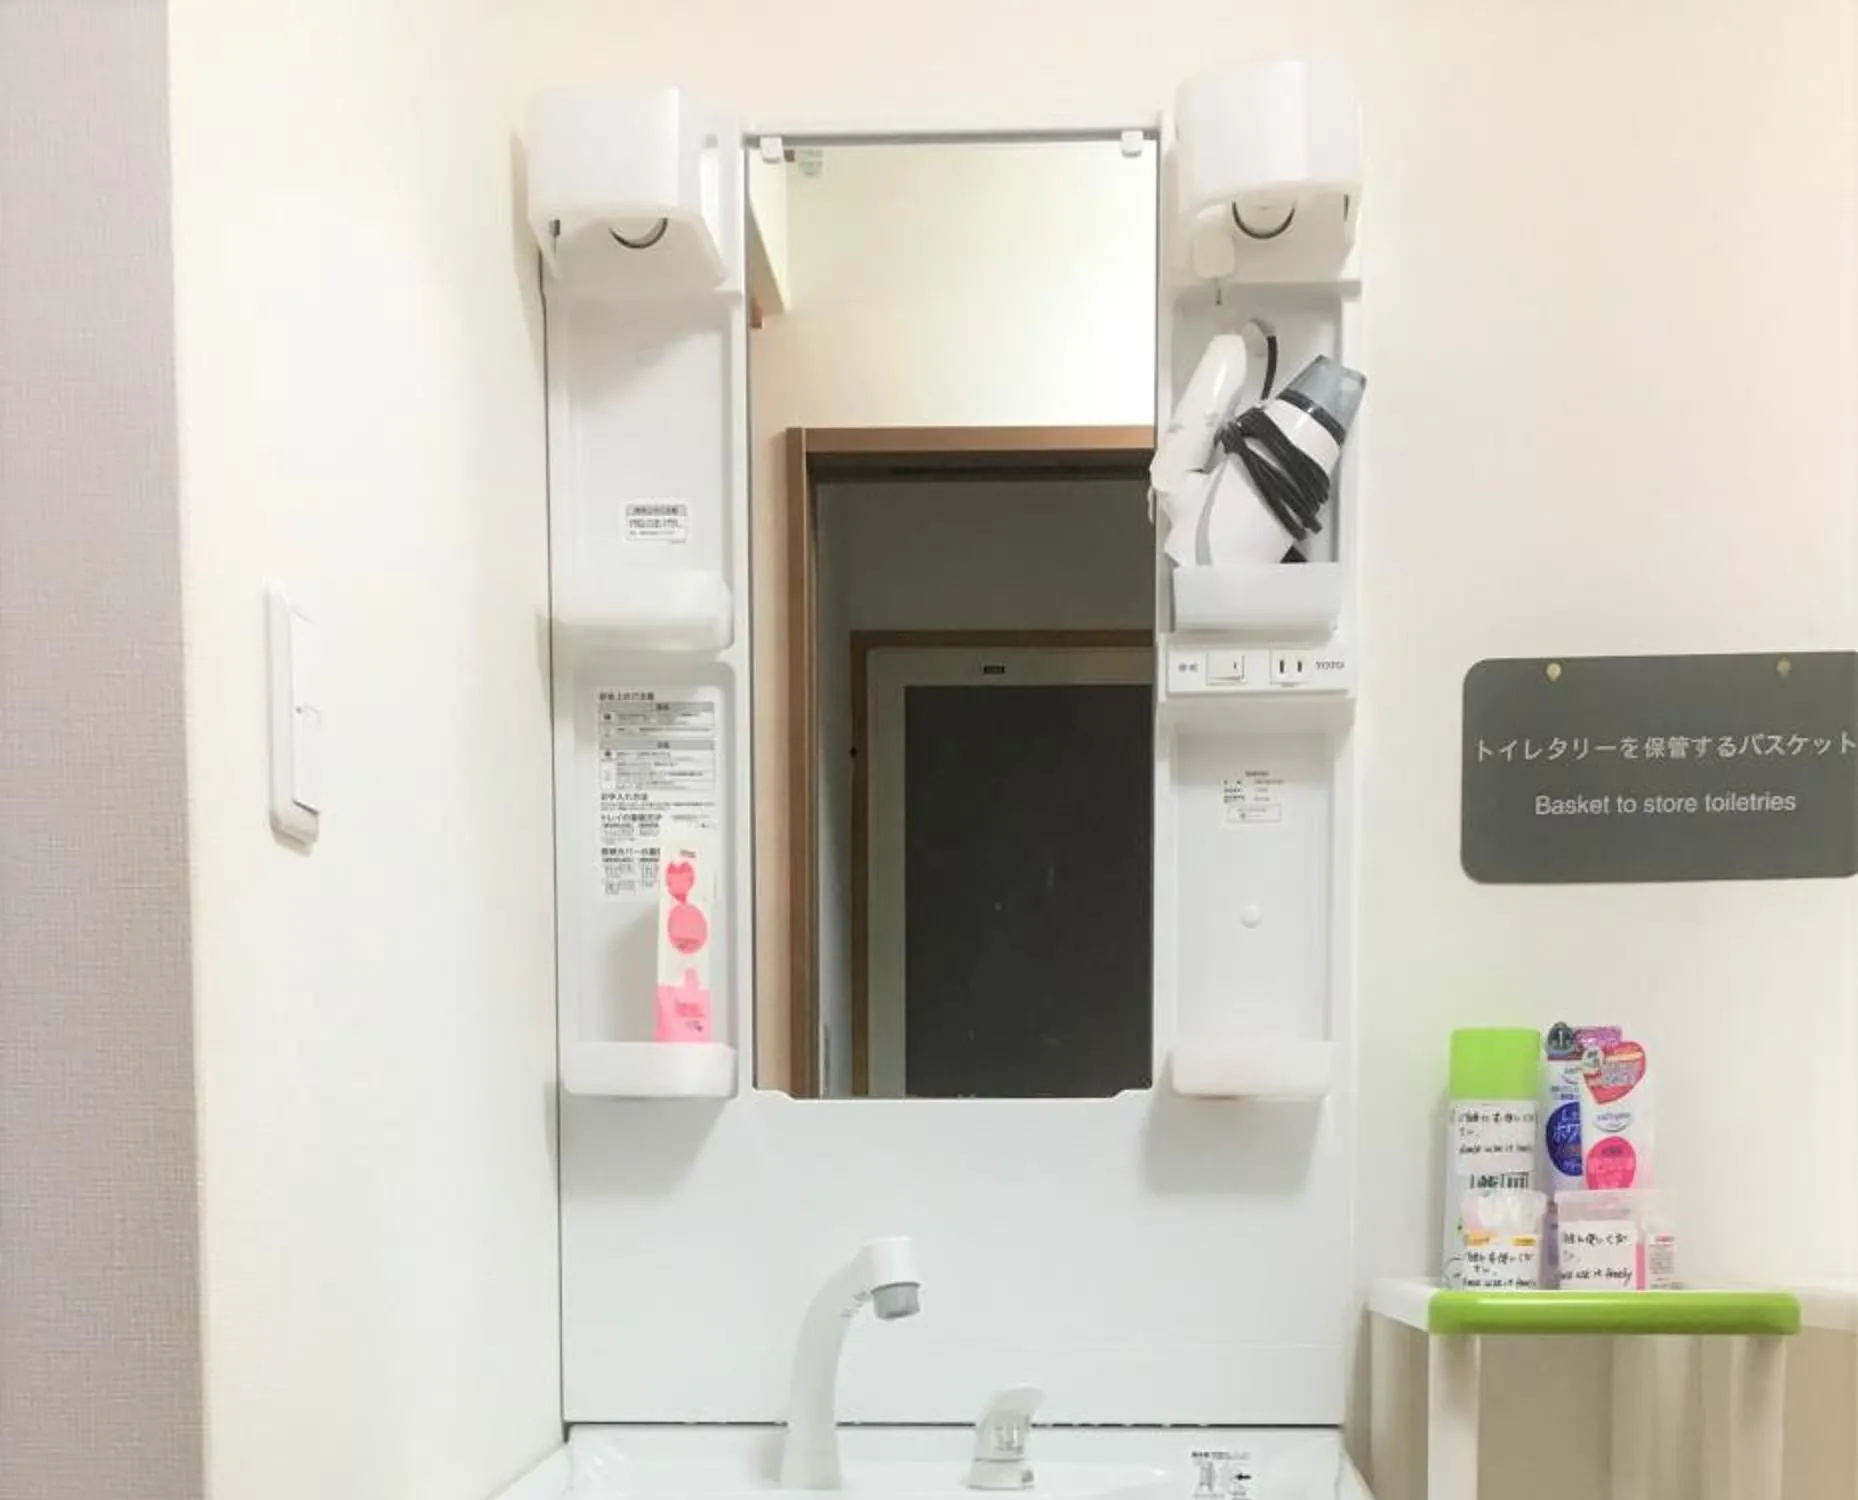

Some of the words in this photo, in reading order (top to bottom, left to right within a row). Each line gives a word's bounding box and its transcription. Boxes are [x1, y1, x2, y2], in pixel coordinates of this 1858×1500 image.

[1476, 731, 1857, 762] トイレタリーを保管するバスケット
[1535, 794, 1610, 816] Basket
[1616, 795, 1637, 814] to
[1643, 795, 1698, 814] store
[1704, 792, 1797, 814] toiletries
